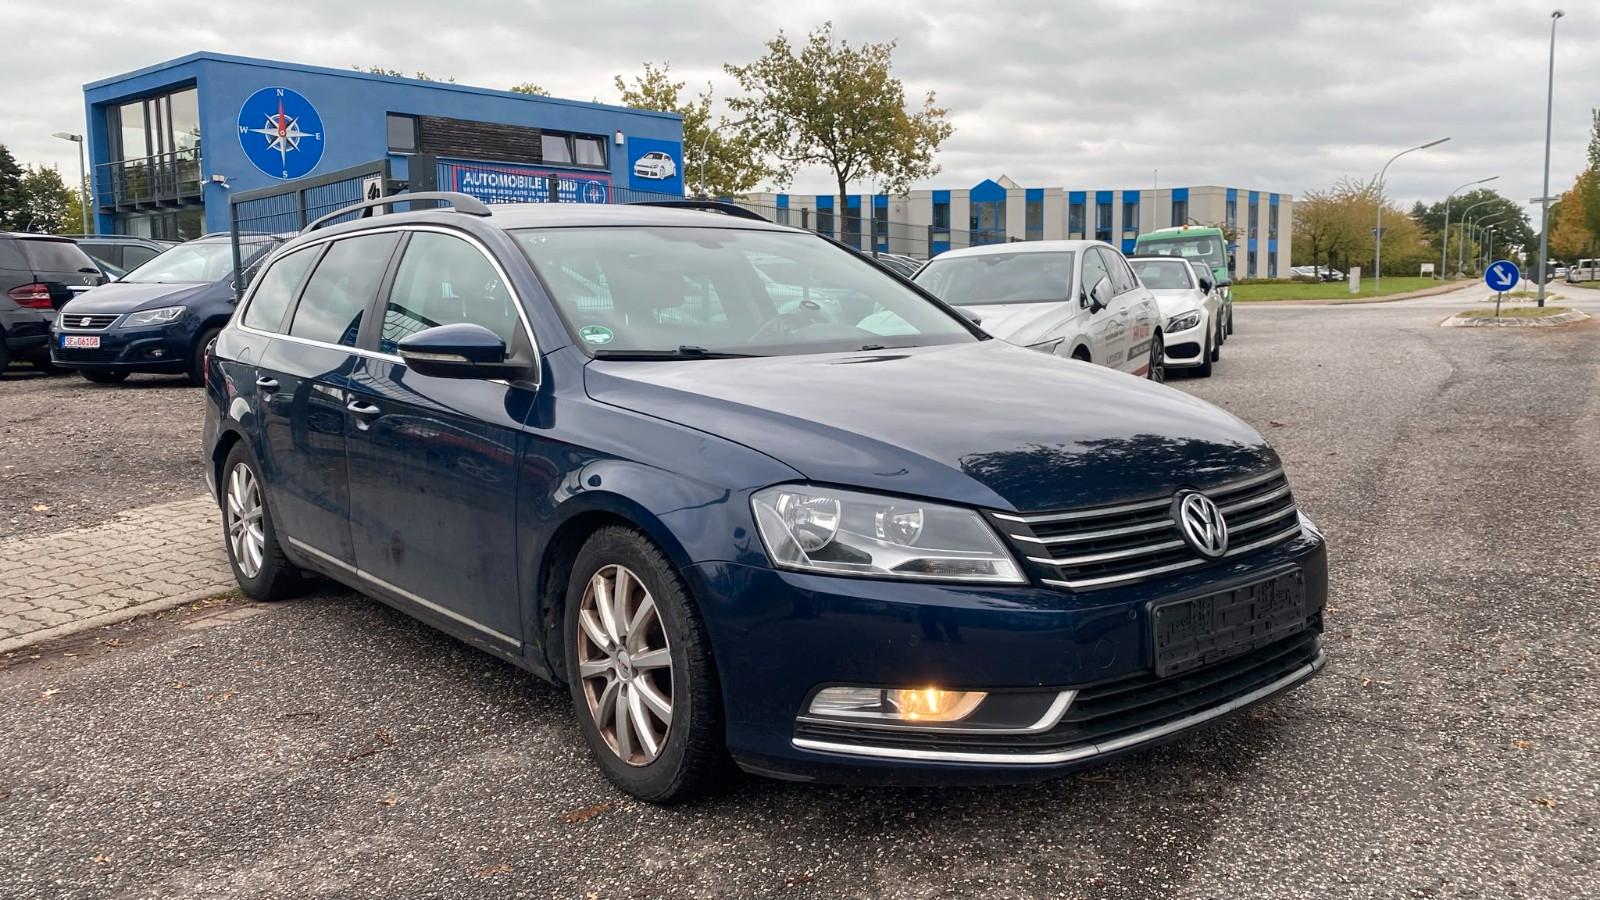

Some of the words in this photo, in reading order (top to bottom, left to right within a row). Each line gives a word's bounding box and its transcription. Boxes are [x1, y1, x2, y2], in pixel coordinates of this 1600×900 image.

[276, 89, 284, 97] N
[239, 126, 249, 134] W
[463, 172, 542, 189] AUTOMOBILE
